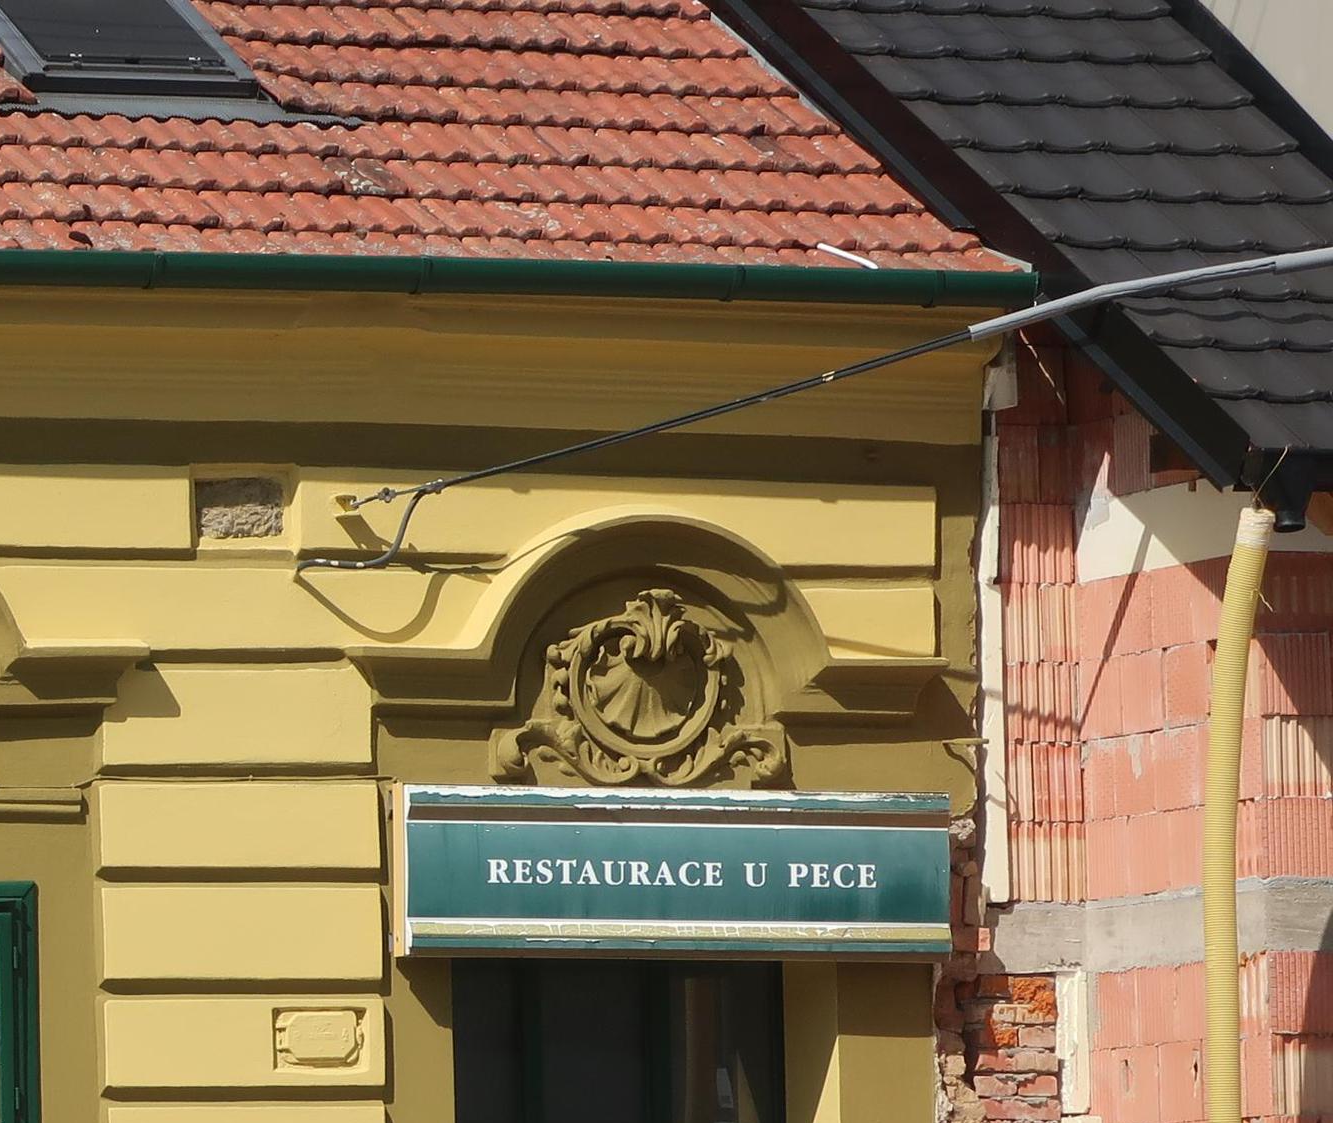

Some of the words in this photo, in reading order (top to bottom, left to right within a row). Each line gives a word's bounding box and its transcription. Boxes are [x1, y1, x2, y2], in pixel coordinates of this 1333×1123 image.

[486, 858, 724, 889] RESTAURACE
[743, 862, 769, 888] U
[787, 863, 878, 889] PECE
